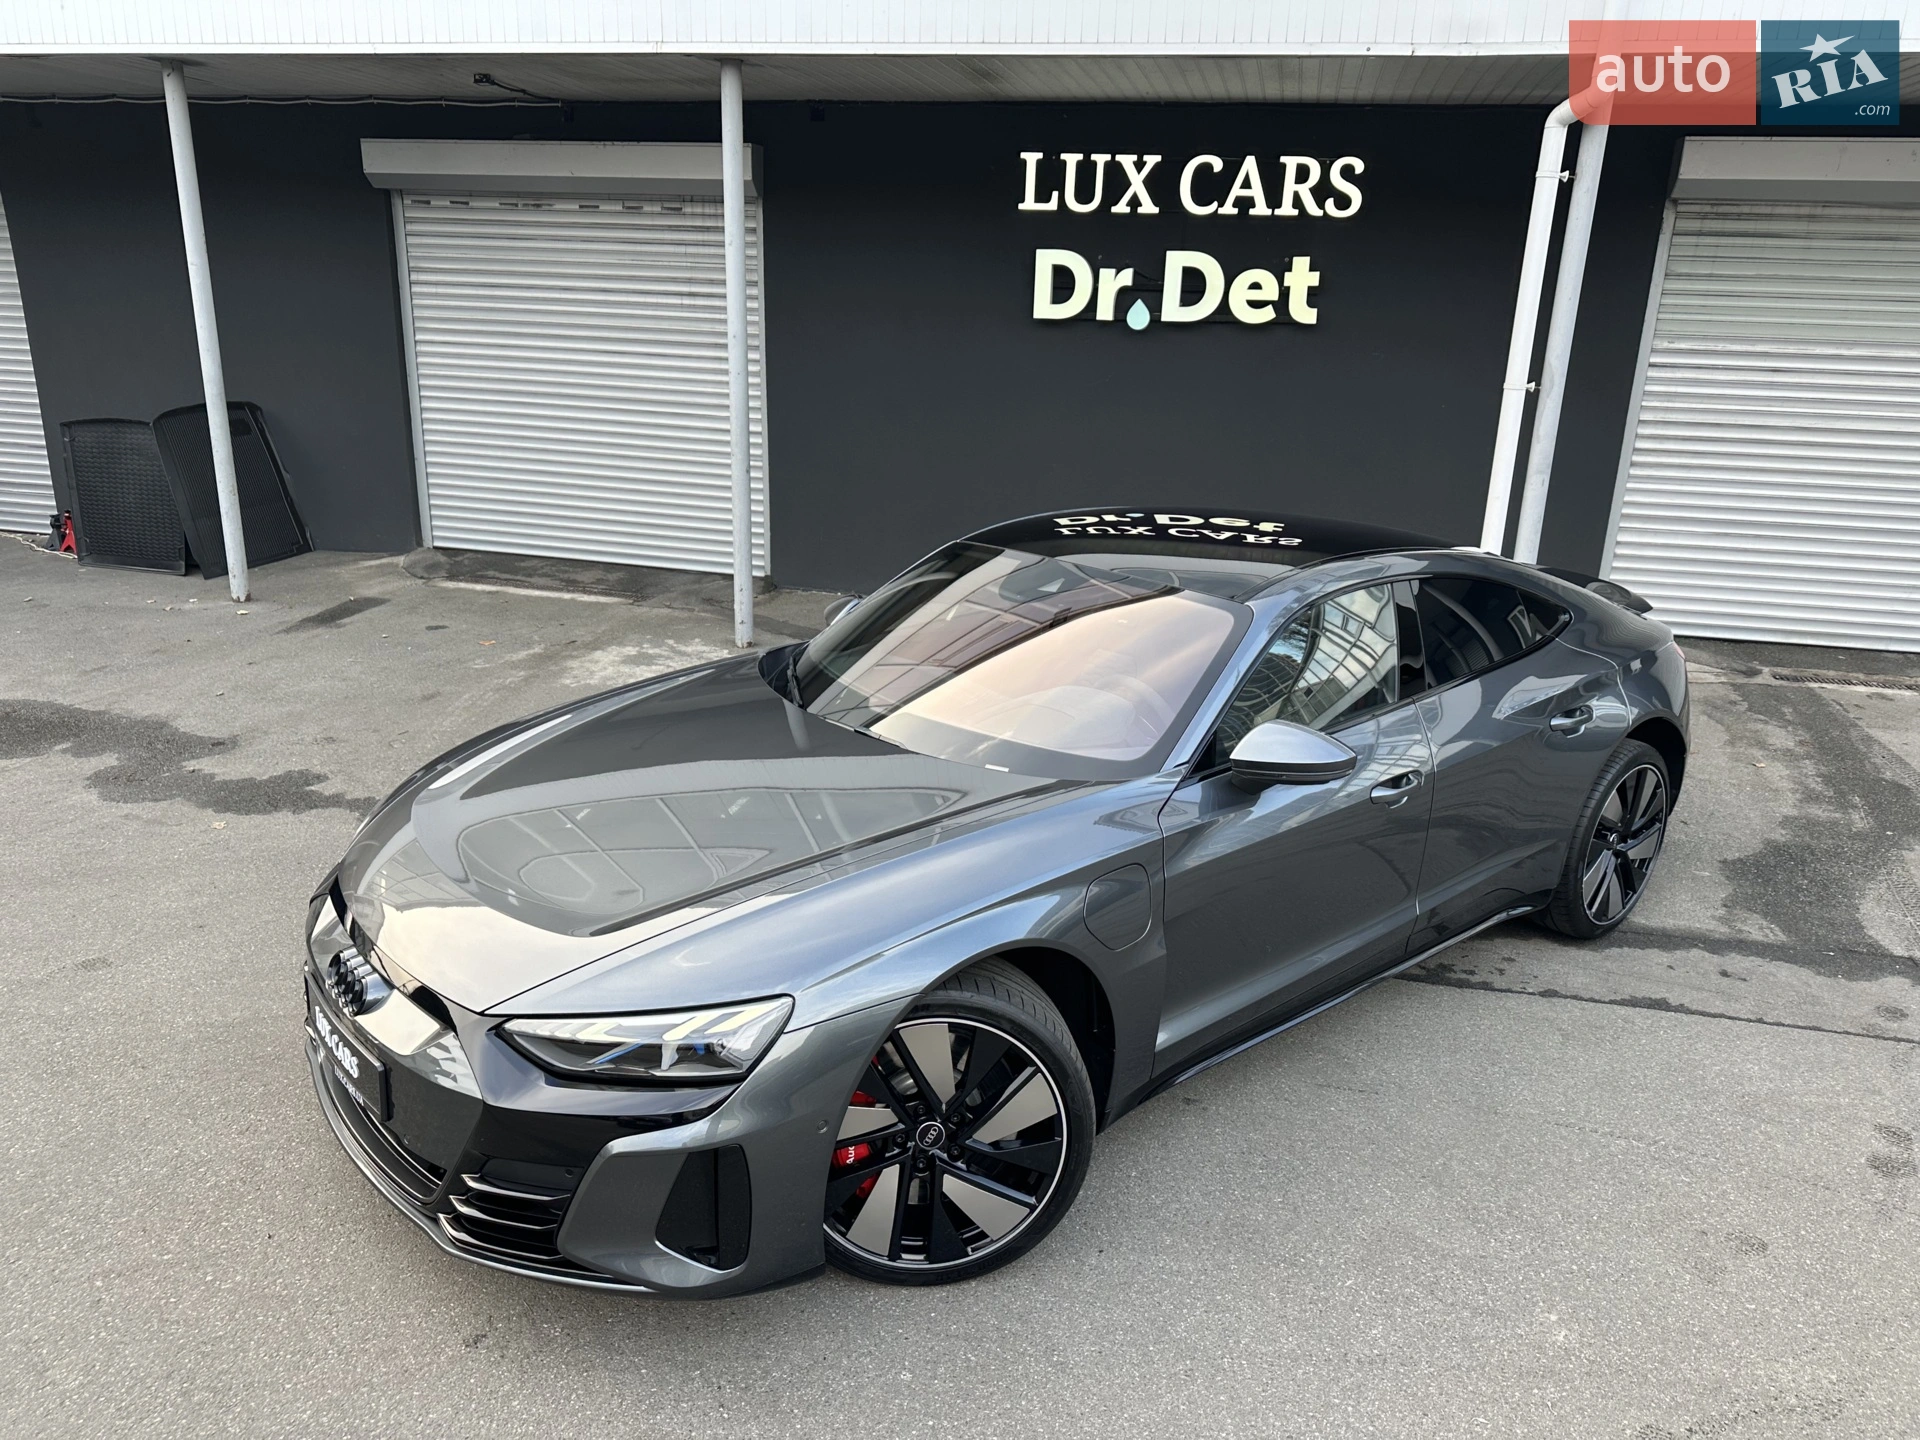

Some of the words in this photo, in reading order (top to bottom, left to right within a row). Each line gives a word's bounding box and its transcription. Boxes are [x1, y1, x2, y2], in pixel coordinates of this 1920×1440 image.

[1017, 151, 1162, 214] LUX
[1179, 154, 1365, 218] CARS
[315, 1005, 333, 1048] LUX
[331, 1034, 360, 1079] CARS
